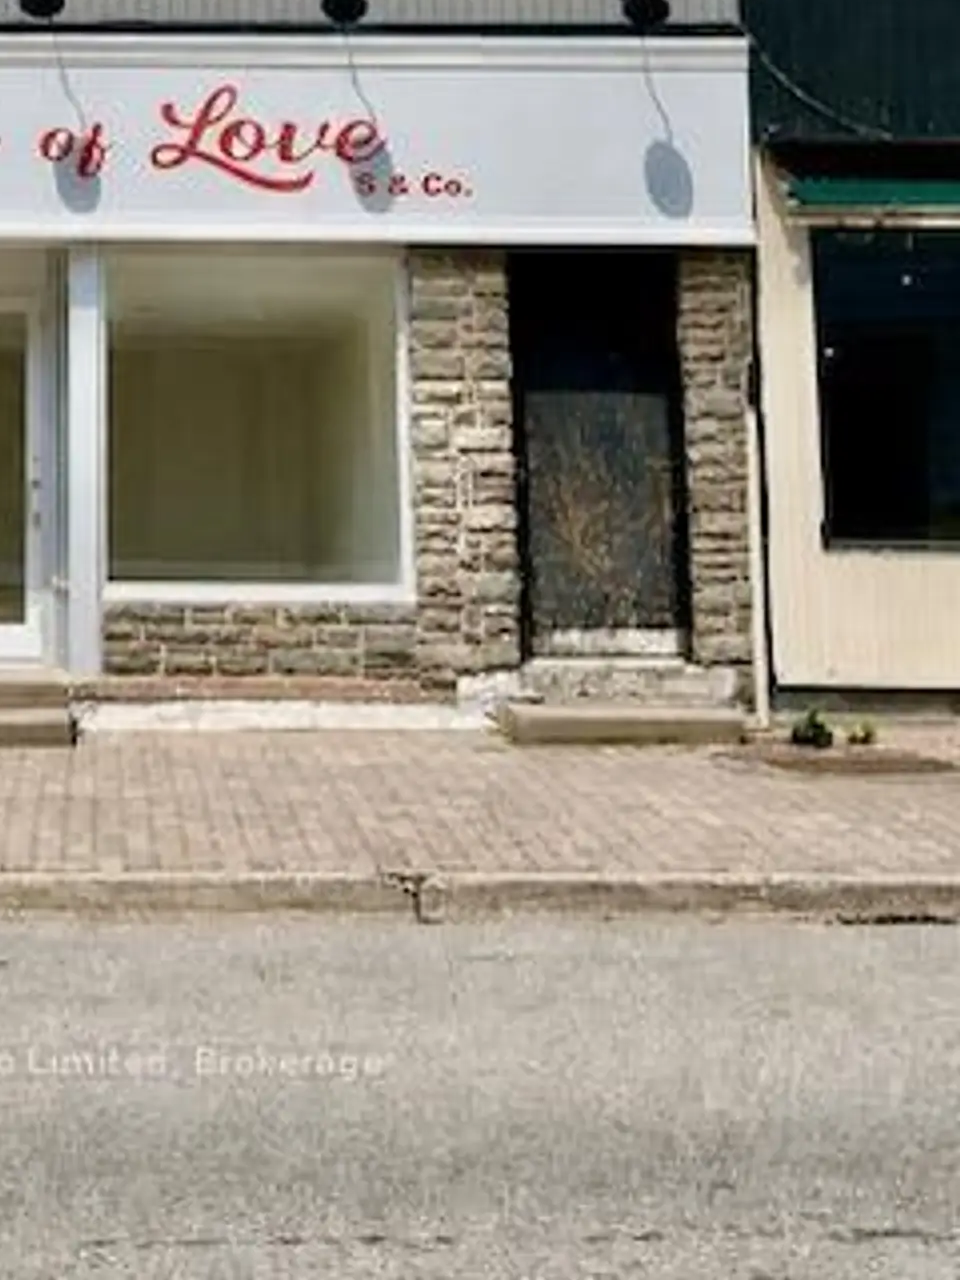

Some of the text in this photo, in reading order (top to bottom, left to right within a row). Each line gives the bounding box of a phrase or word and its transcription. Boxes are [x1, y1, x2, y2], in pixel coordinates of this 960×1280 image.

[40, 122, 107, 178] of
[150, 84, 386, 192] Love
[388, 174, 408, 196] &
[421, 172, 473, 198] Co.
